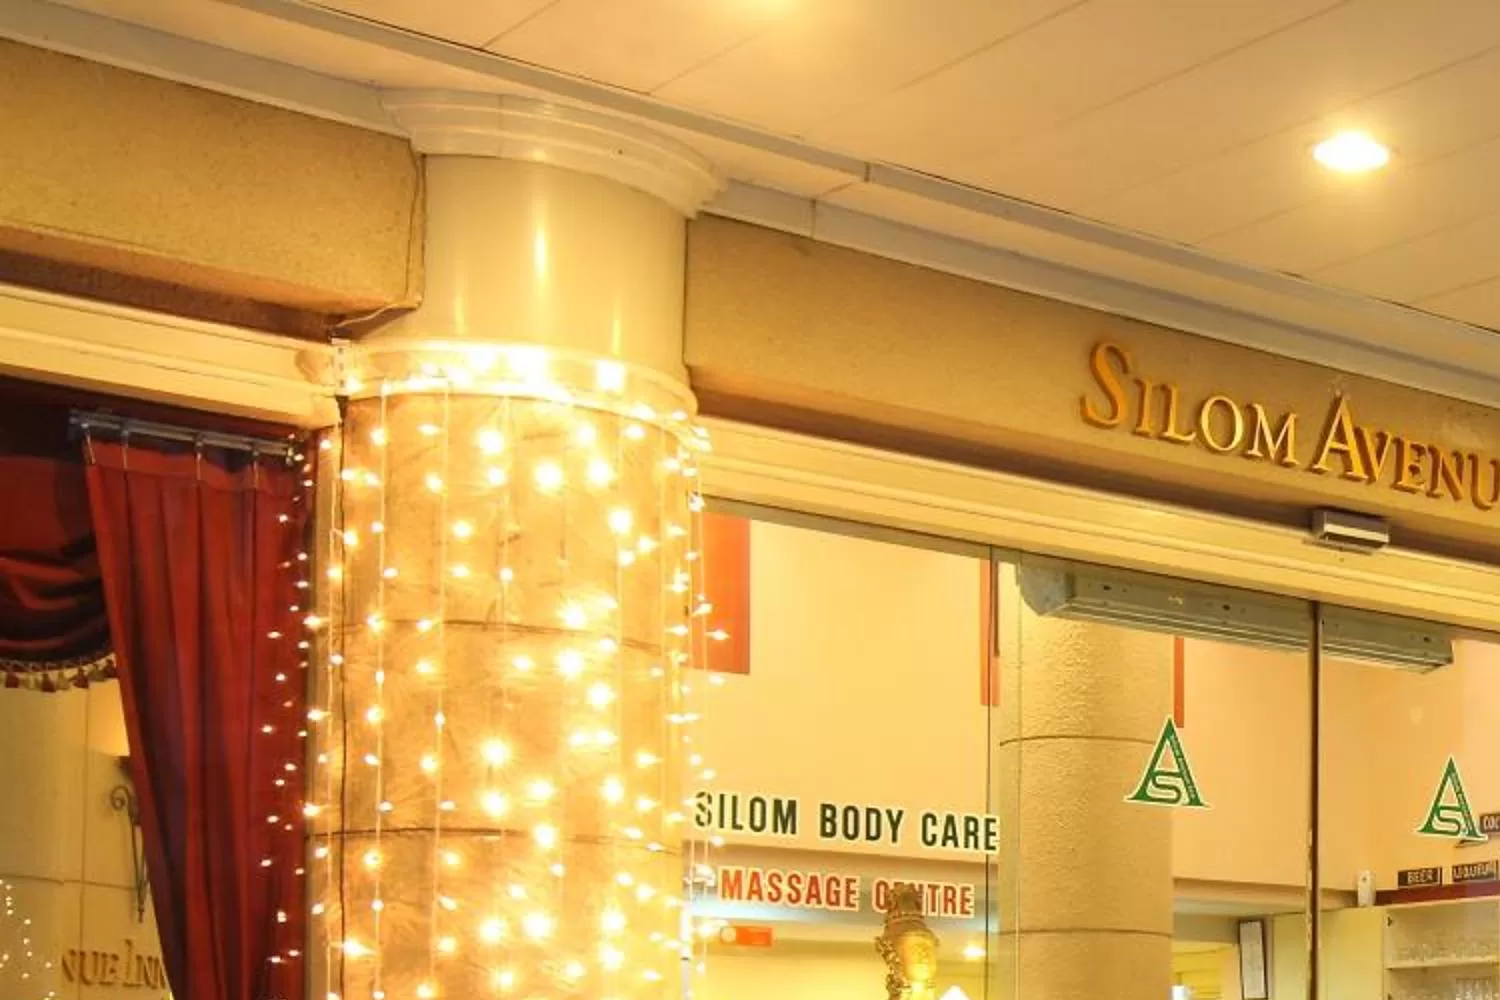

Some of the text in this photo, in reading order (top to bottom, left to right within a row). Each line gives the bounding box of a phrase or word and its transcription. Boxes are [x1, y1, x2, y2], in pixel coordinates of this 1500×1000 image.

[1081, 340, 1299, 467] SILOM
[694, 791, 998, 851] SILOM BODY CARE
[720, 868, 972, 915] MASSAGE CNTRE
[1407, 869, 1434, 883] BEER
